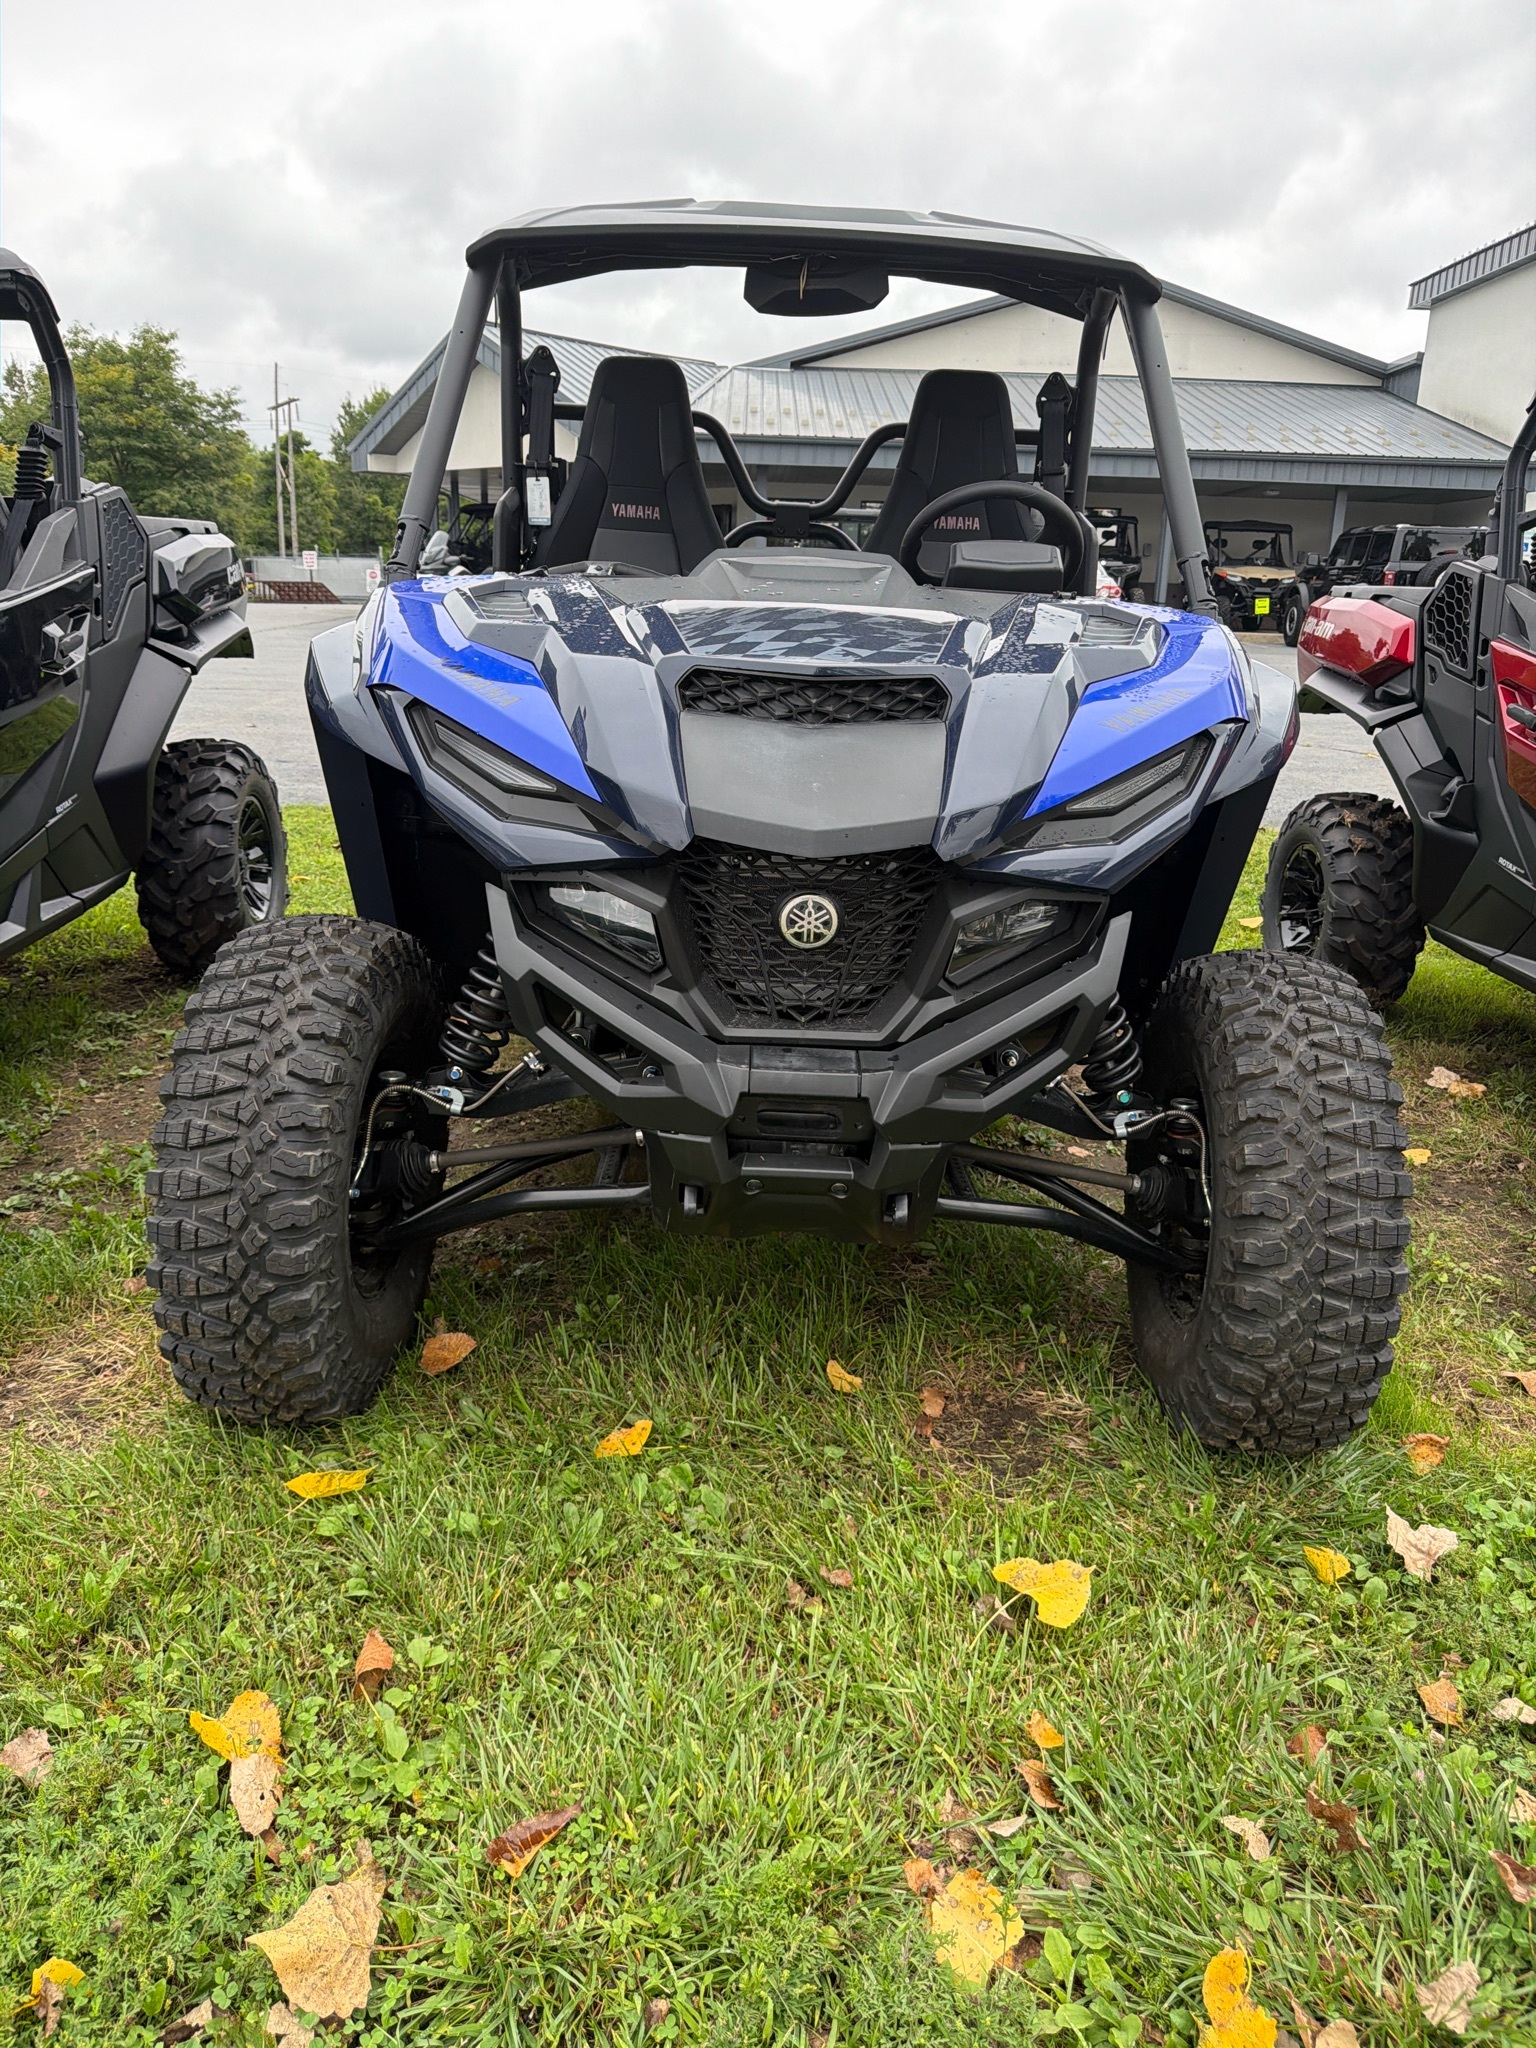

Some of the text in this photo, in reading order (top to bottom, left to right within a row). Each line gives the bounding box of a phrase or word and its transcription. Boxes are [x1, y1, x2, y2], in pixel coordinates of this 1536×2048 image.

[611, 502, 660, 520] YAMAHA
[428, 657, 521, 708] YAMAHA
[1097, 689, 1197, 732] YAMAHA
[1498, 856, 1517, 872] ROTAX
